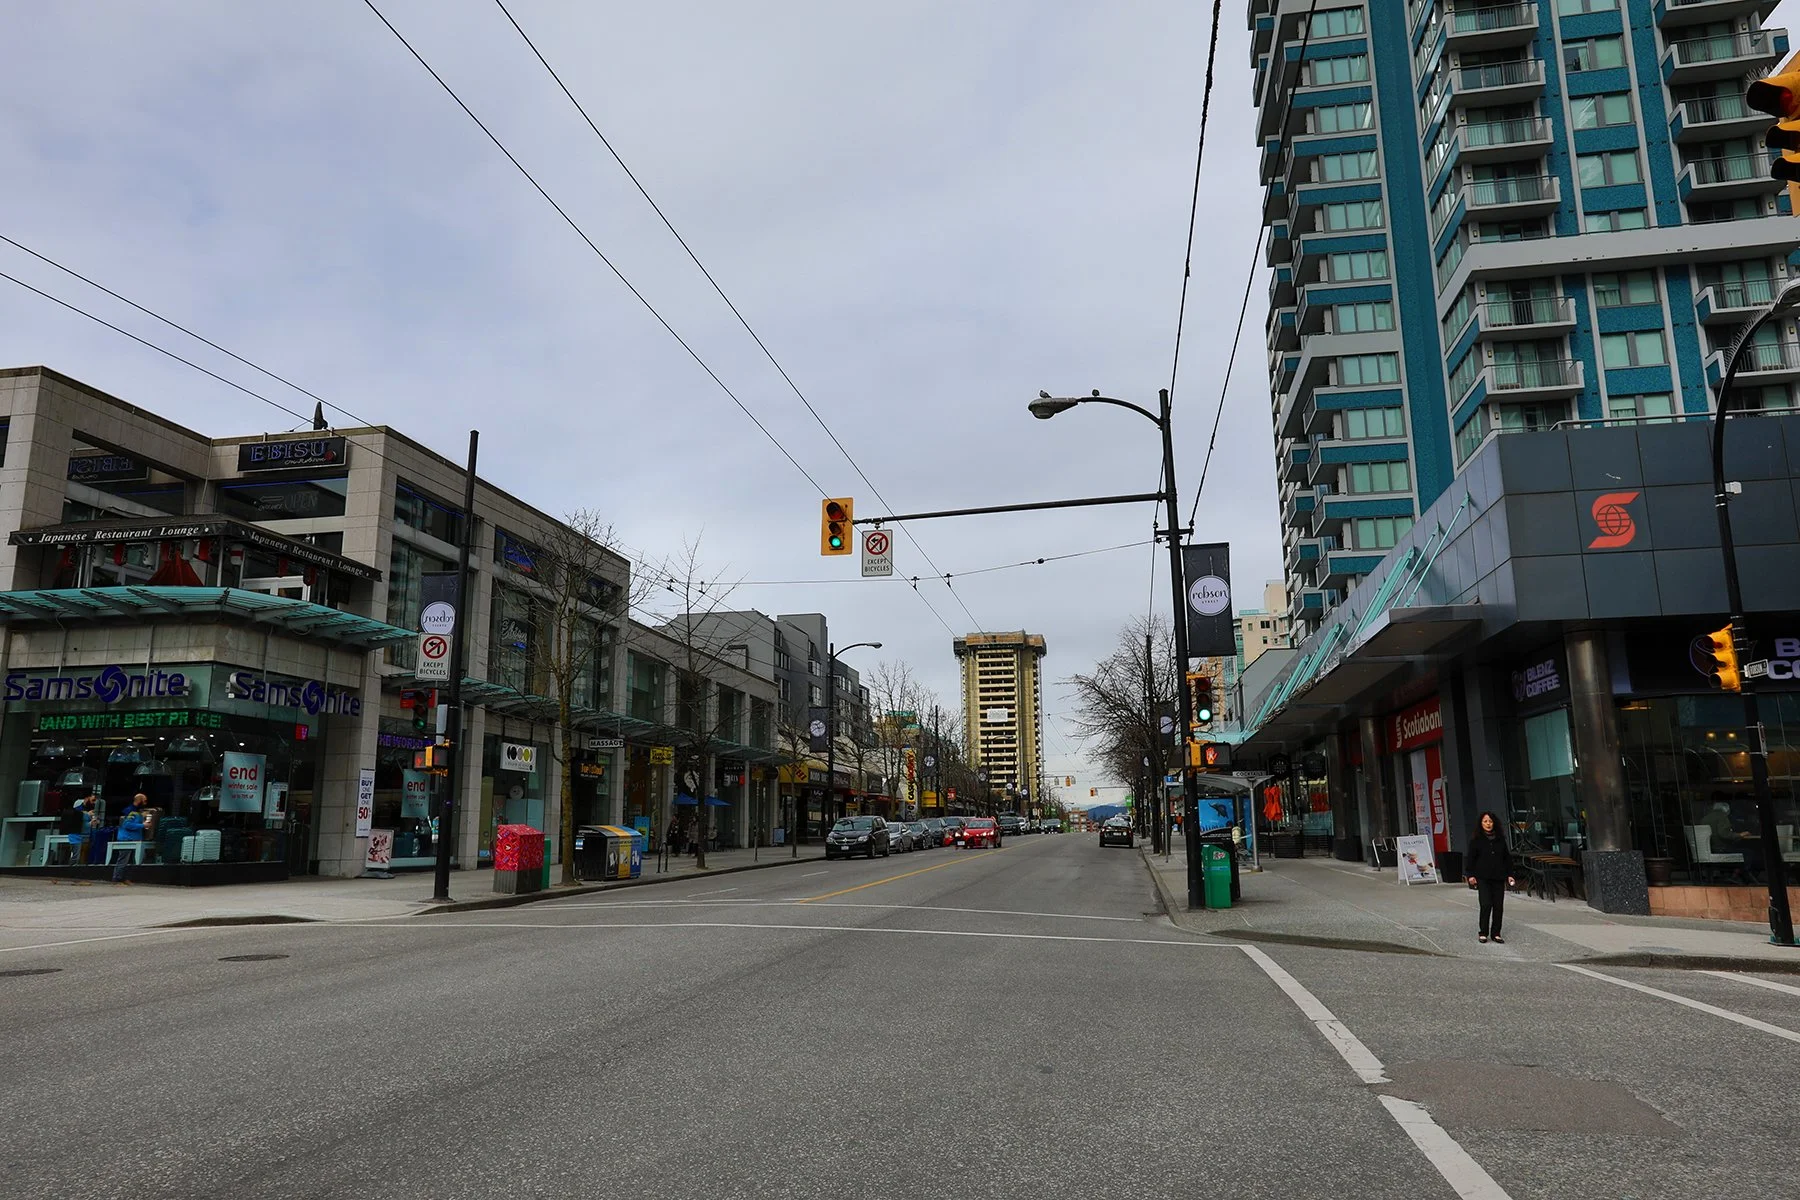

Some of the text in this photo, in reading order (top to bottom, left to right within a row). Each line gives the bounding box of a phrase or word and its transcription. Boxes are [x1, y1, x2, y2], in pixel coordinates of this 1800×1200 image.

[250, 441, 328, 463] EBISU
[39, 526, 200, 544] Japanese Restaurant Lounge
[250, 530, 364, 577] Japanese Restaurant Lounge
[865, 565, 890, 573] BICYCLES
[1192, 585, 1229, 600] robson
[1527, 659, 1556, 682] BLENZ
[1526, 674, 1560, 697] COFFEE
[81, 713, 121, 729] WITH
[229, 764, 258, 780] end
[407, 781, 426, 792] end
